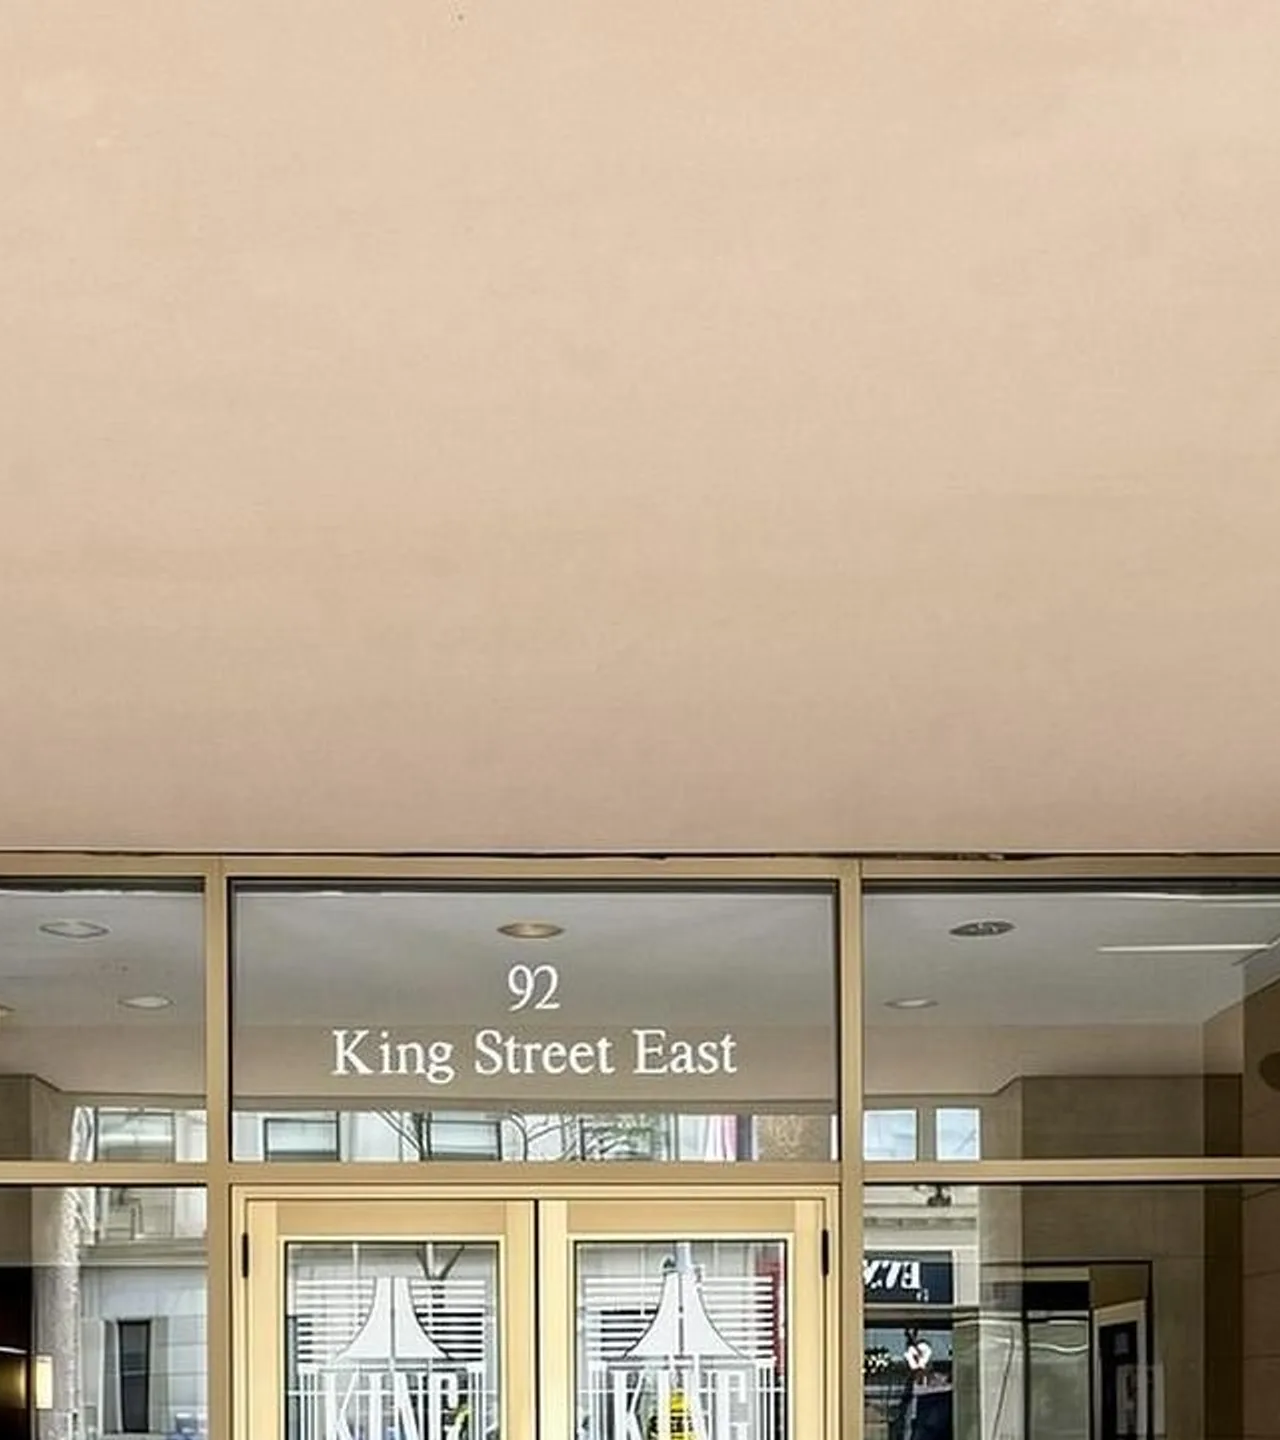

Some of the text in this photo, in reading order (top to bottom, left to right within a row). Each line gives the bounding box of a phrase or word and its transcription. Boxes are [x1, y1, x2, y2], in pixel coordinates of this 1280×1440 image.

[507, 963, 561, 1012] 92
[332, 1028, 738, 1084] King Street East
